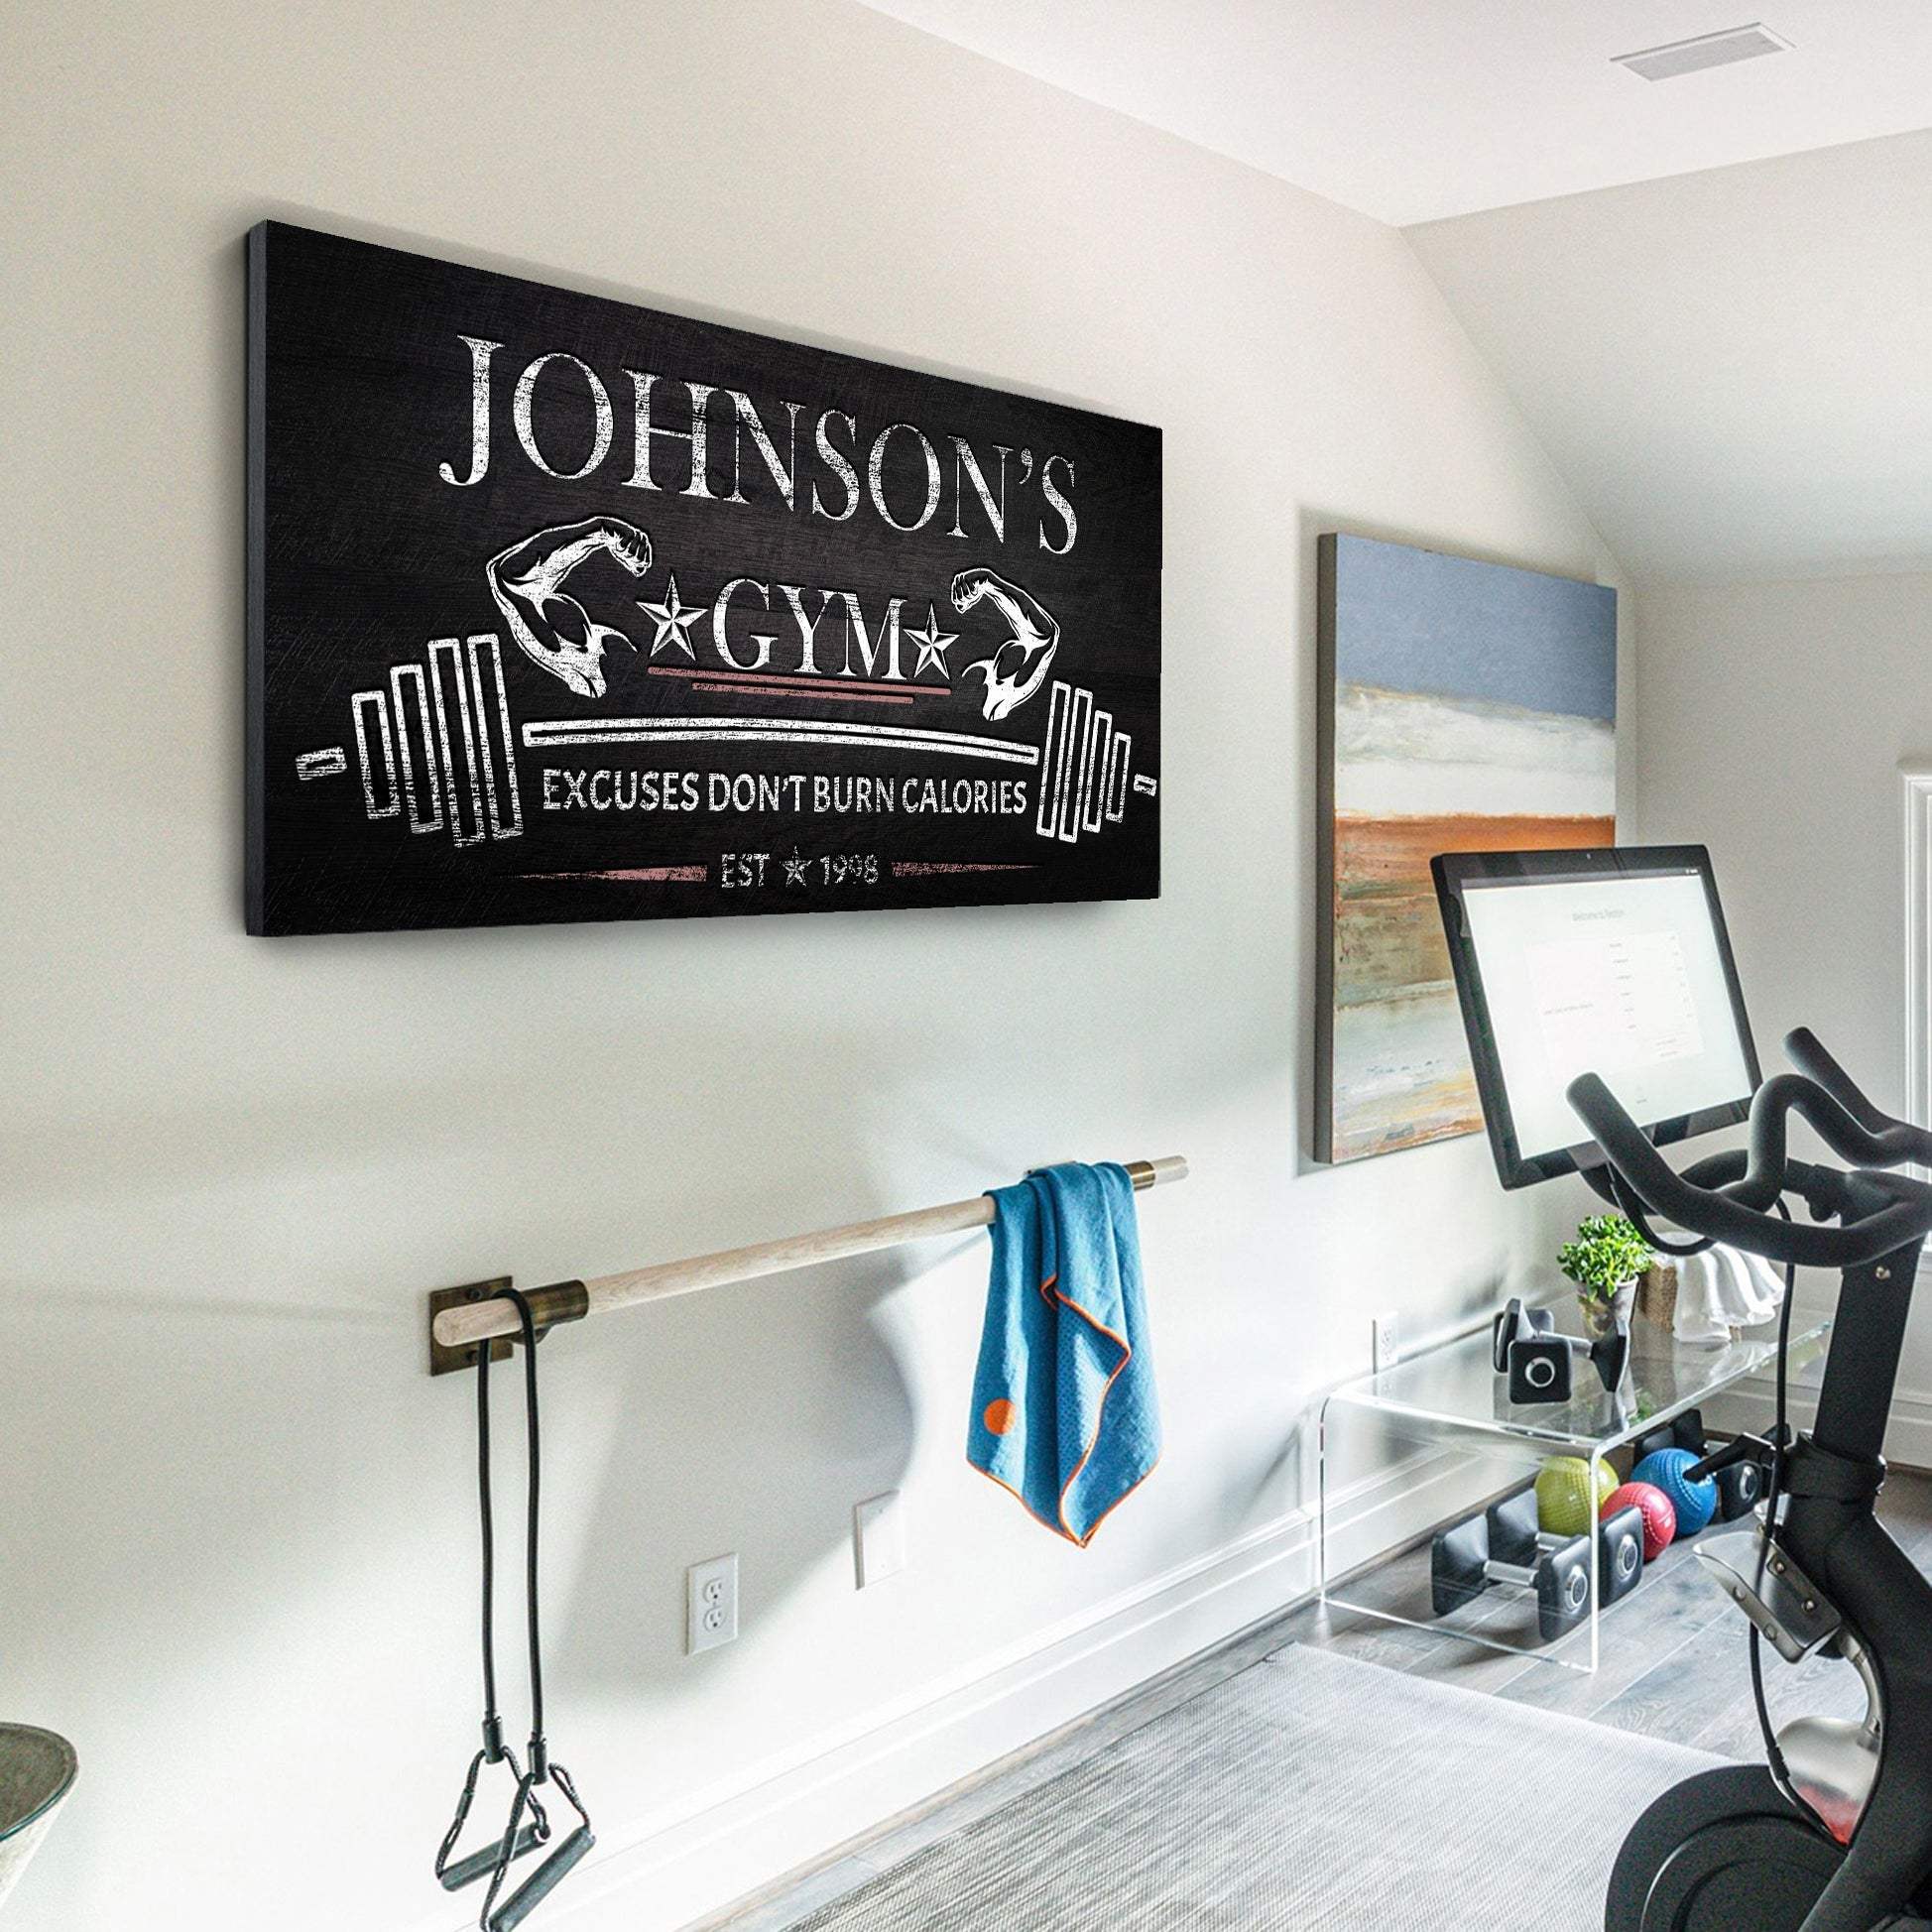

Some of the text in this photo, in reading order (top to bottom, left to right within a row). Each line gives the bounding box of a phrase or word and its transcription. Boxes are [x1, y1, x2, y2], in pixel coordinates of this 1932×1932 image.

[439, 335, 1077, 555] JOHNSON'S
[712, 578, 907, 680] GYM
[543, 769, 1027, 814] EXCUSES DON'T BURN CALORIES
[721, 853, 879, 889] EST 1998
